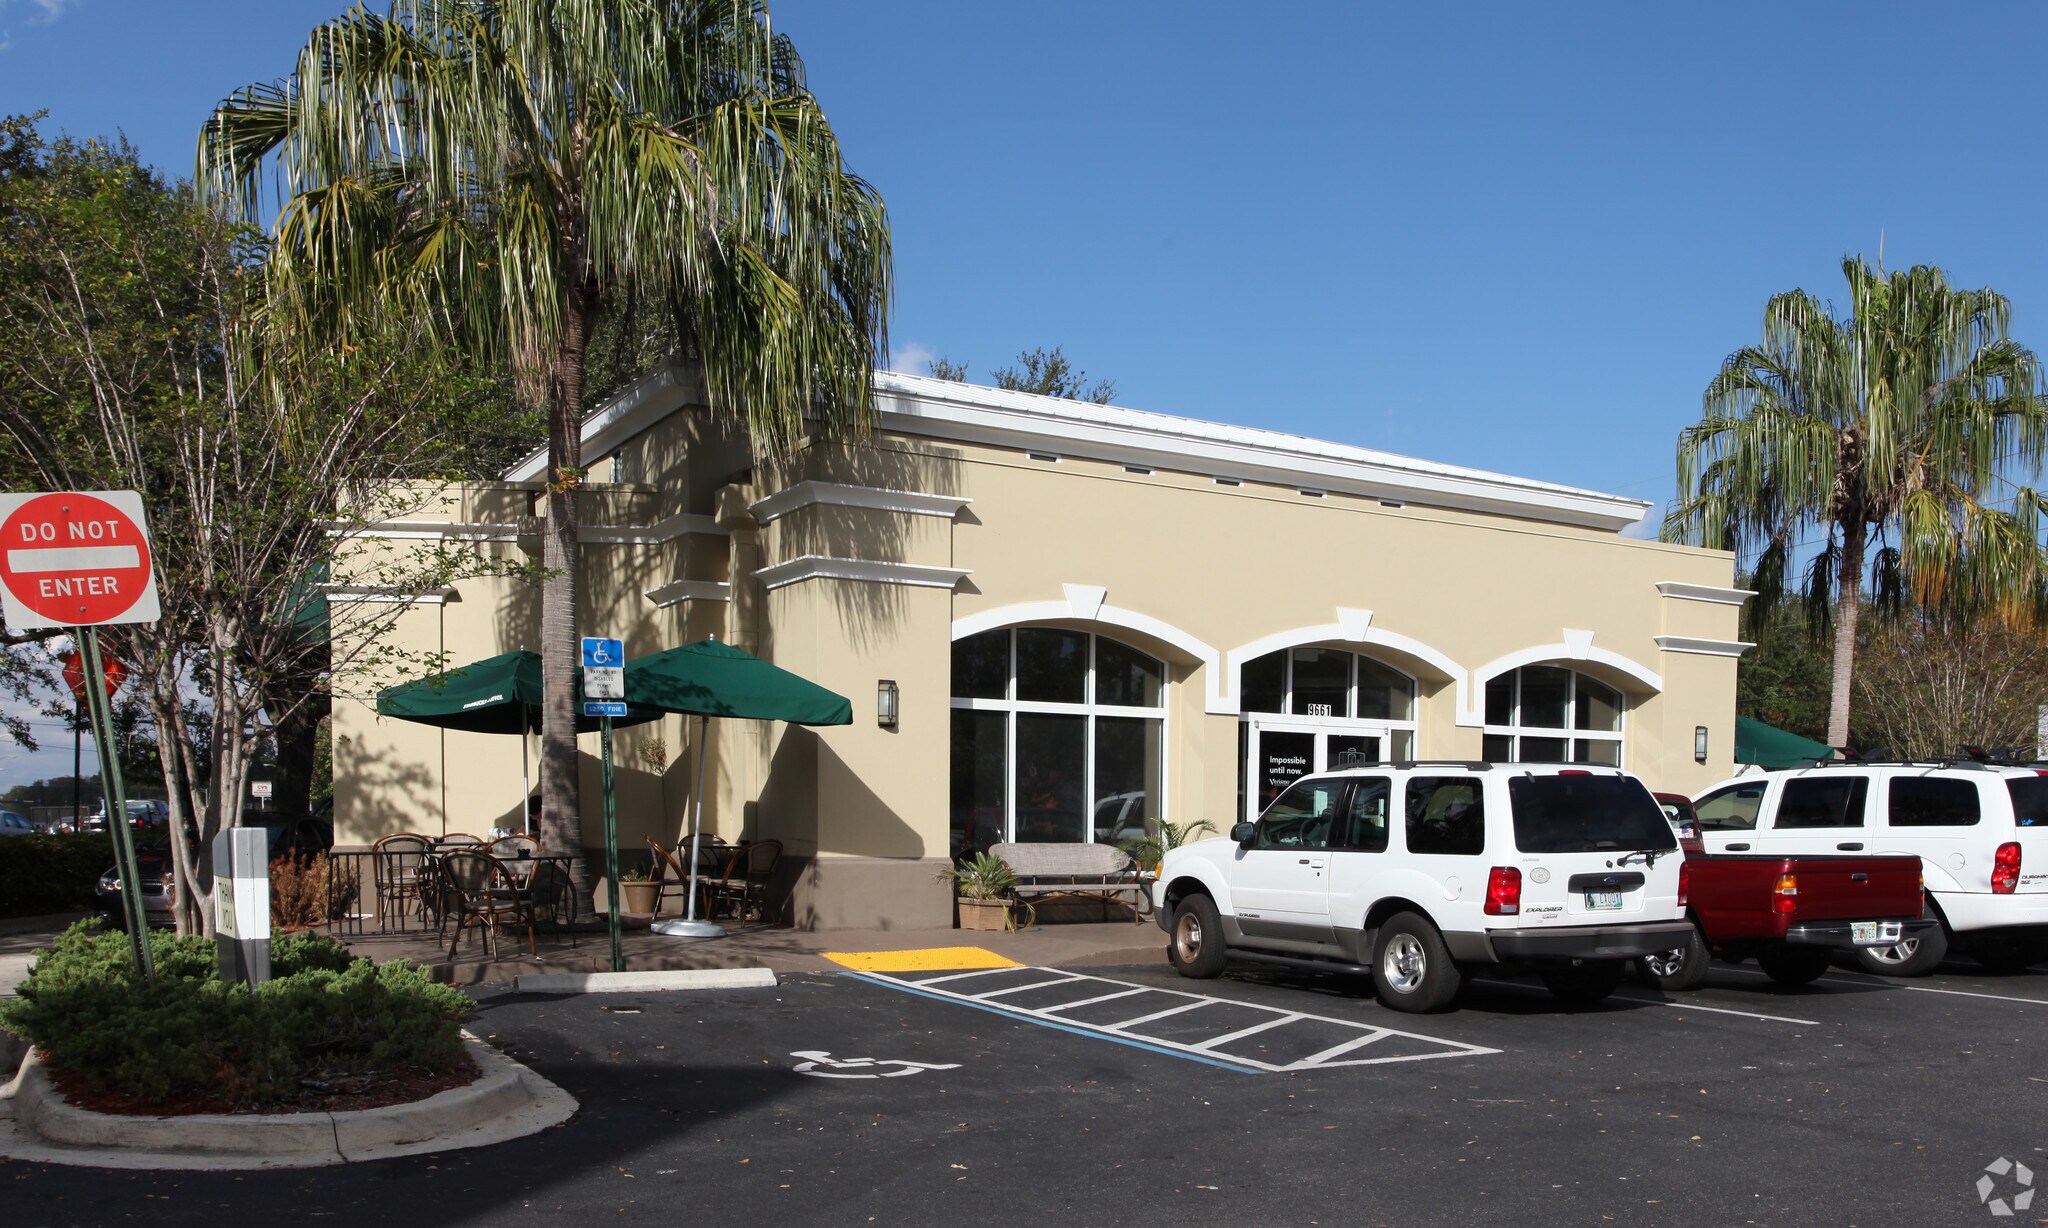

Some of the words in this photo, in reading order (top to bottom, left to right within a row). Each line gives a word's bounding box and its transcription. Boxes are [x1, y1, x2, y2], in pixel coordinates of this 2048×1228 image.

[20, 523, 56, 542] DO
[68, 520, 119, 540] NOT
[39, 576, 120, 598] ENTER
[1308, 704, 1330, 716] 9661
[1269, 755, 1306, 765] Impossible
[1269, 766, 1285, 774] until
[222, 908, 233, 930] YOU
